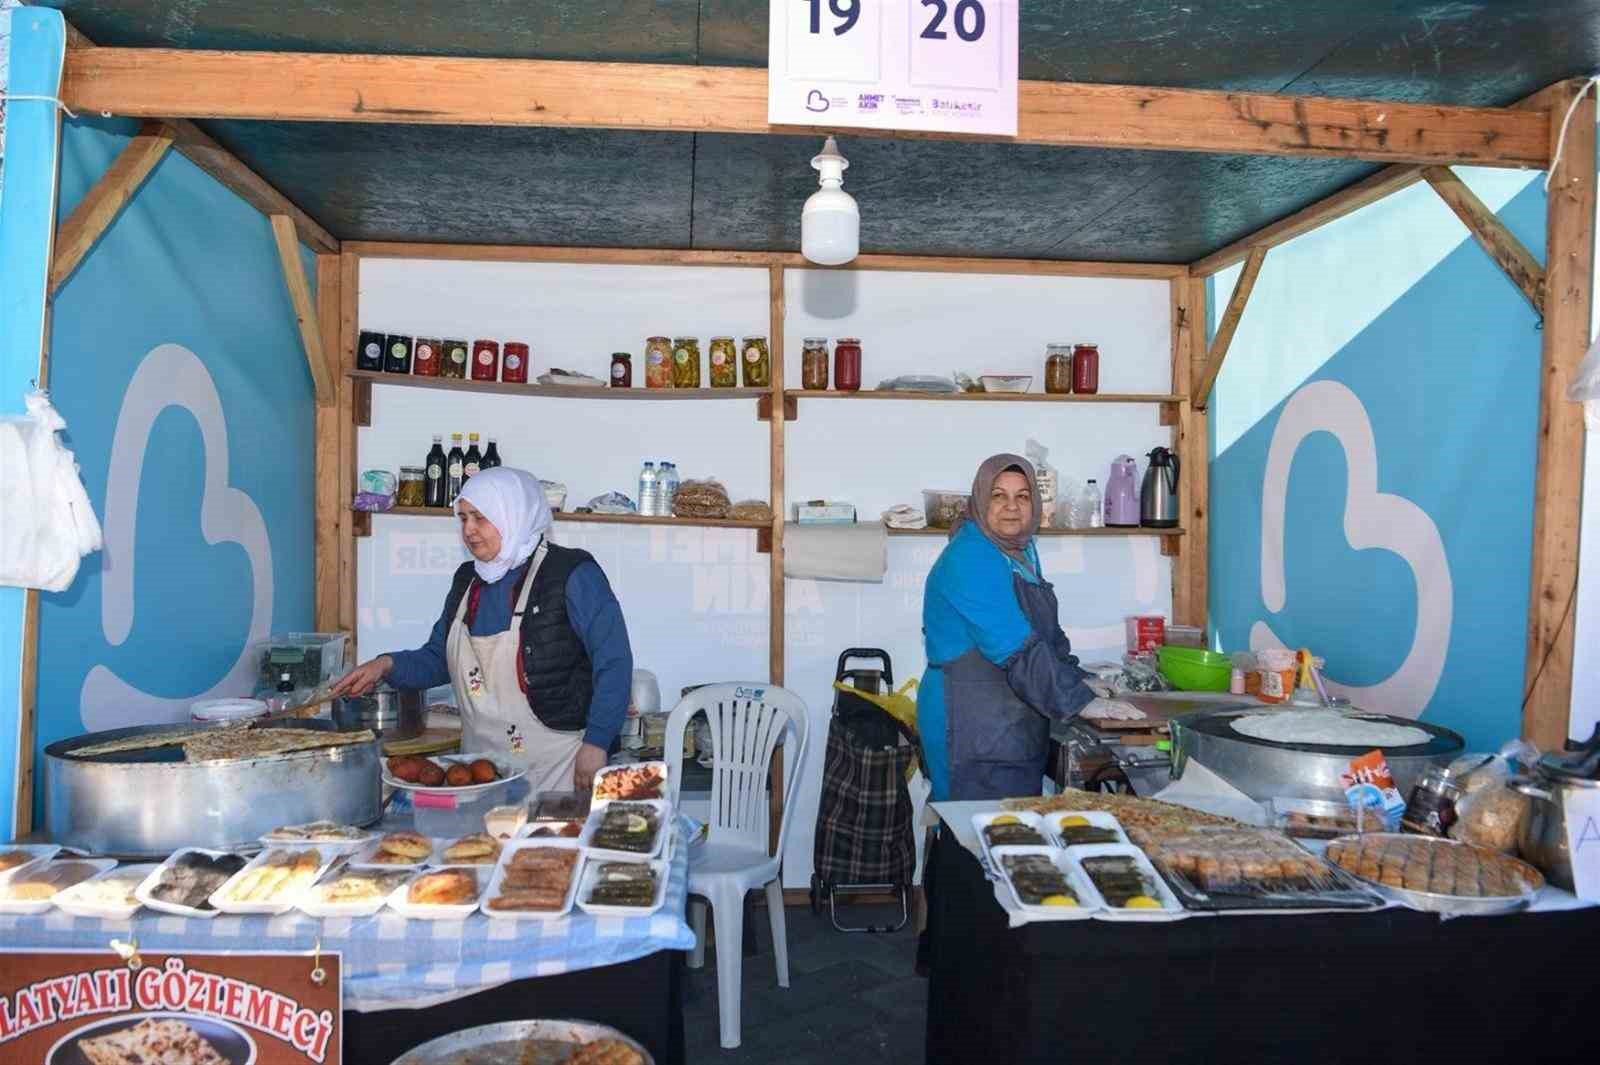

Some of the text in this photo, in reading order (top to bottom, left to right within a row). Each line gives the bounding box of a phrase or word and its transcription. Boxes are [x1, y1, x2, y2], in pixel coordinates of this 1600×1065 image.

[803, 0, 986, 42] 19 20
[136, 957, 332, 1062] GÖZLEMECİ
